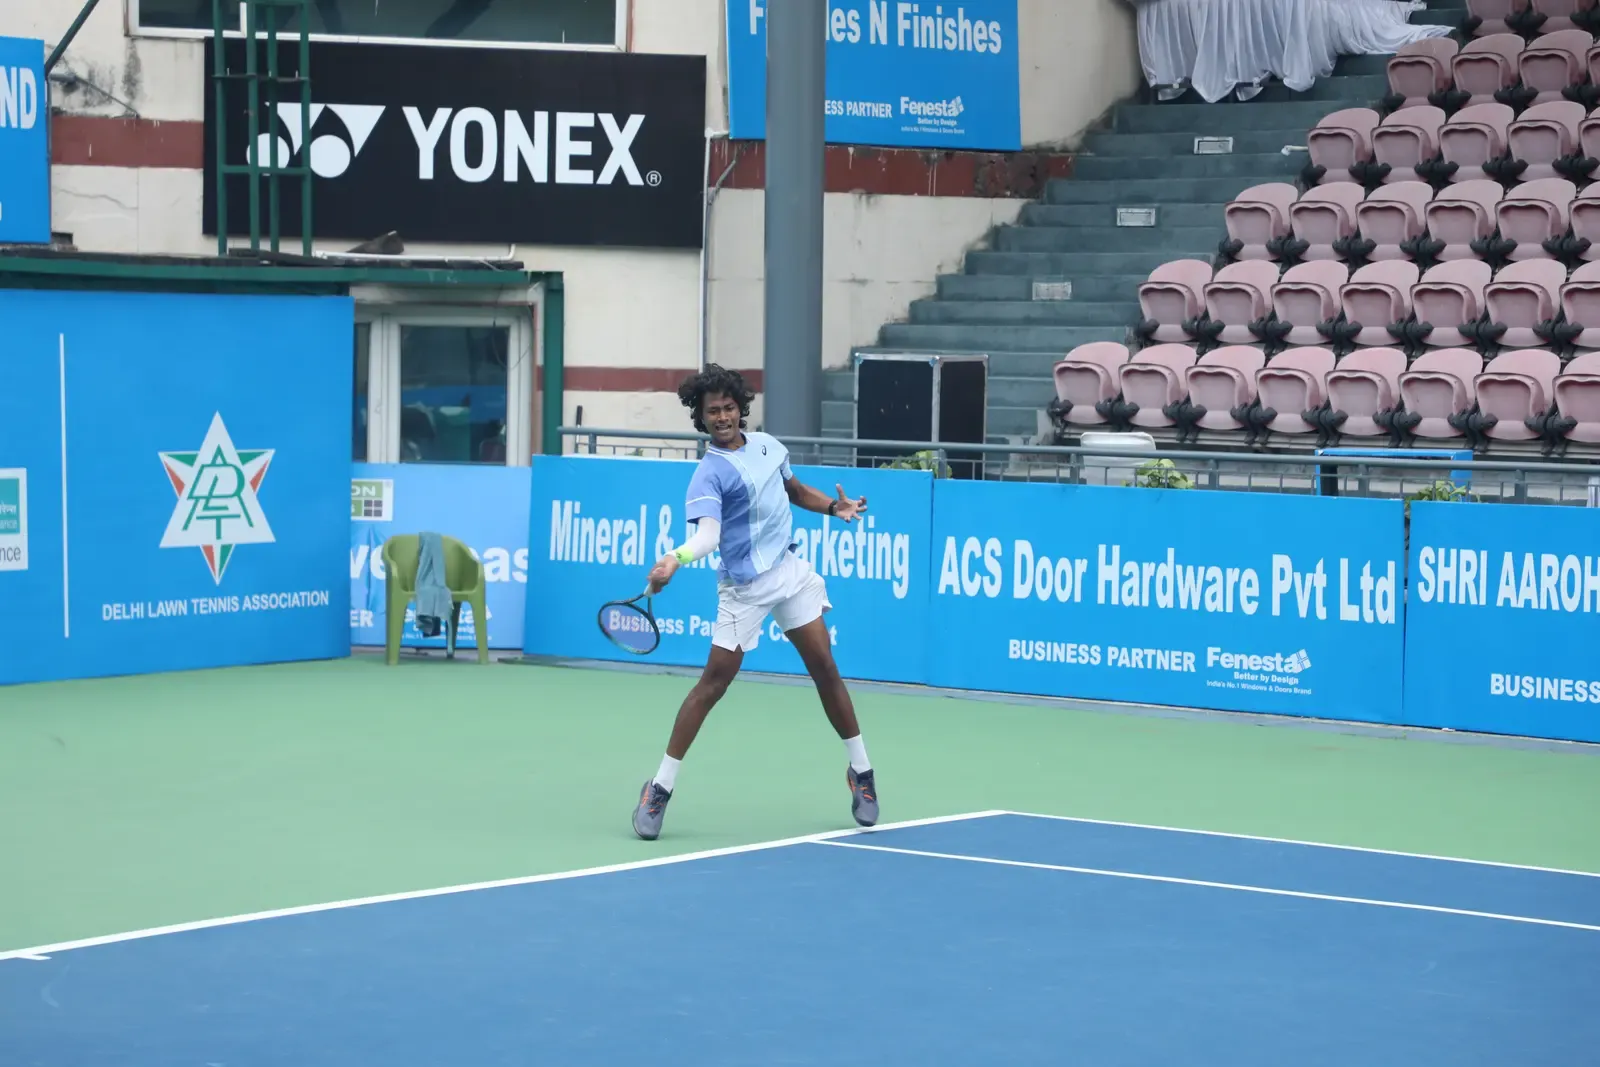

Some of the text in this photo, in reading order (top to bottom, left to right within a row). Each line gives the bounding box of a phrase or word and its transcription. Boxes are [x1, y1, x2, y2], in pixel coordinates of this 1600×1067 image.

[897, 3, 1002, 54] Finishes
[846, 101, 892, 118] PARTNER
[900, 96, 960, 117] Fenesta
[550, 500, 647, 566] Mineral
[793, 513, 910, 600] arketing
[938, 536, 1396, 625] ACS Door Hardware Pvt Ltd
[1417, 545, 1600, 613] SHRI AAROH
[102, 590, 330, 621] DELHI LAWN TENNIS ASSOCIATION
[1008, 639, 1196, 673] BUSINESS PARTNER
[1207, 646, 1302, 674] Fenesta
[1233, 671, 1299, 685] Better by Design
[1490, 673, 1600, 704] BUSINESS
